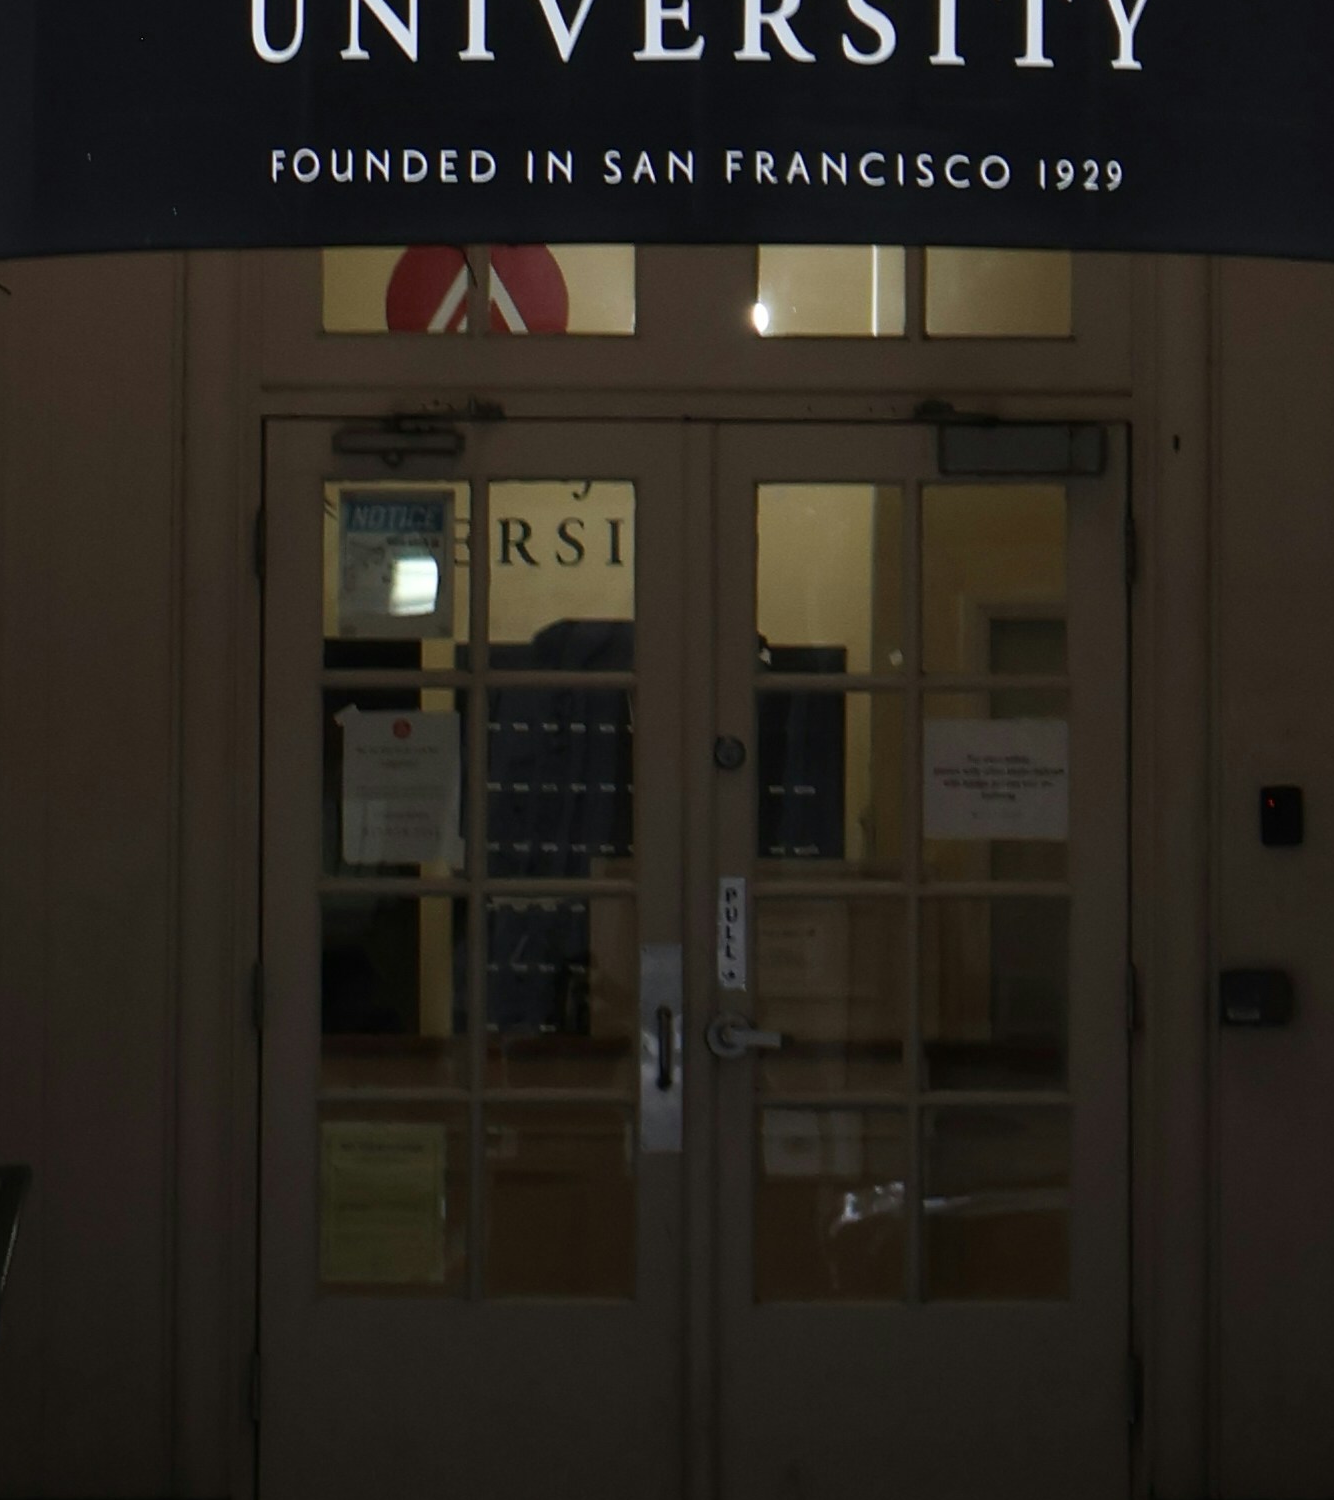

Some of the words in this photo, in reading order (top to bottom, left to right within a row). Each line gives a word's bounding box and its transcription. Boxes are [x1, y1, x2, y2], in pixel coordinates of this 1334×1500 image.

[271, 148, 496, 184] FOUNDED
[527, 150, 573, 184] IN
[603, 149, 694, 184] SAN
[726, 150, 1010, 189] FRANCISCO
[1039, 158, 1123, 191] 1929
[351, 504, 438, 530] NOTICE
[725, 886, 738, 961] PULL
